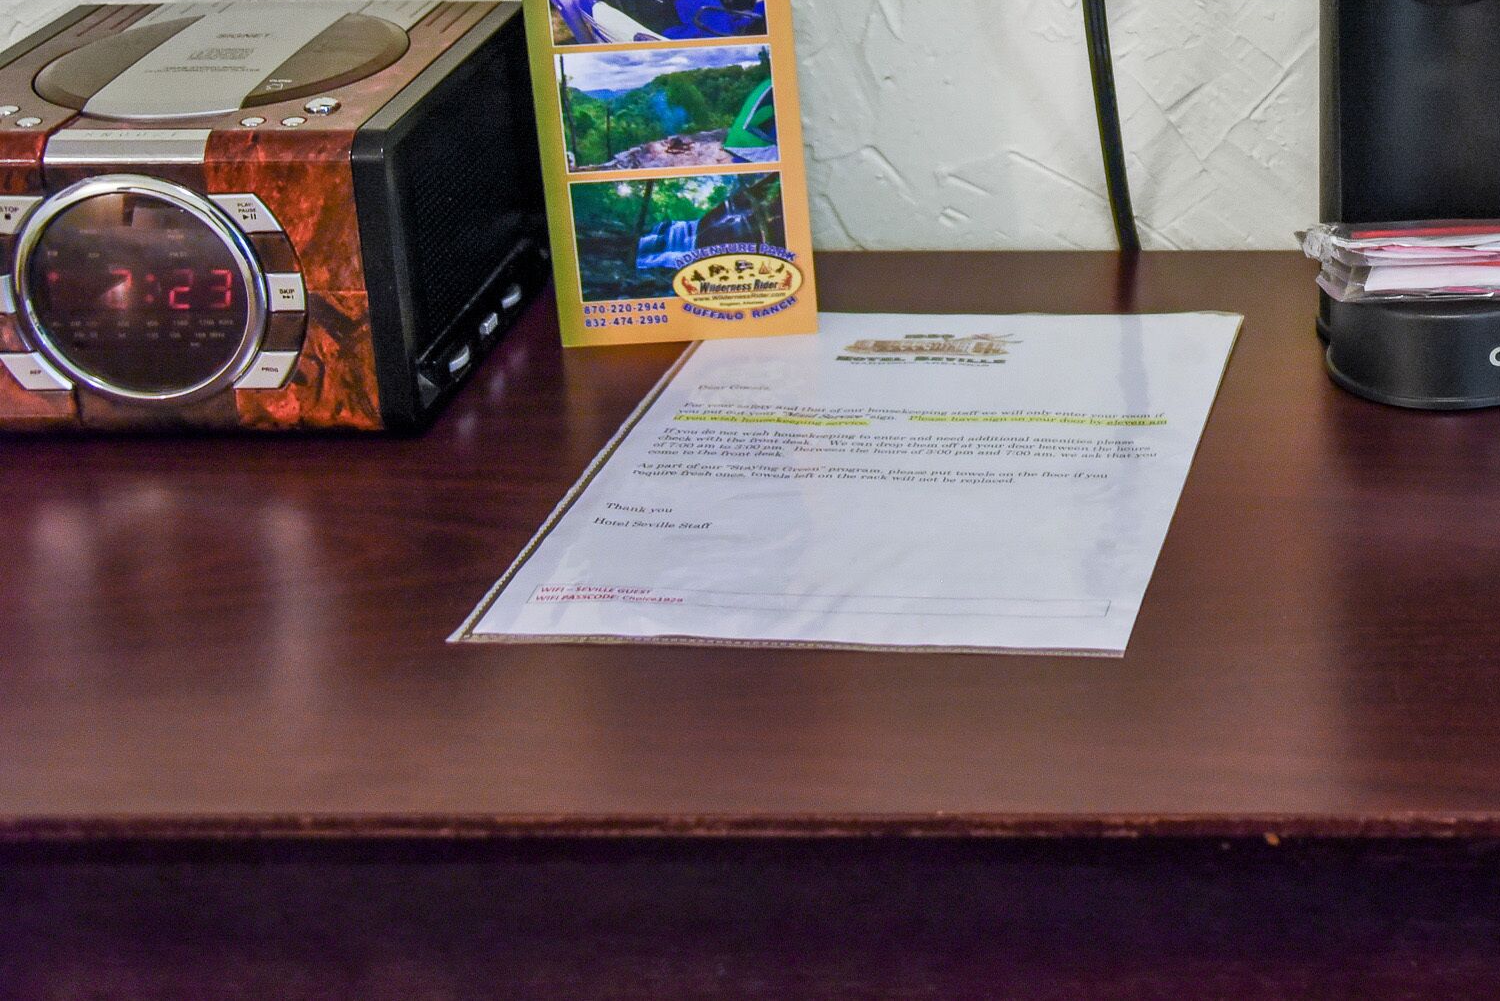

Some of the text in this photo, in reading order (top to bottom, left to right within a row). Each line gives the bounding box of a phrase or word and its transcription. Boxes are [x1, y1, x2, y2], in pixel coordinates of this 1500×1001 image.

[675, 242, 797, 269] ADVENTURE PARK
[700, 278, 779, 293] Wilderness Rider
[584, 302, 667, 315] 870-220-2944
[683, 295, 797, 321] BUFFALO RANCH
[585, 314, 669, 328] 832-474-2990
[658, 434, 692, 442] check
[774, 430, 855, 440] housekeeping
[606, 502, 646, 513] Thank
[594, 517, 628, 527] Hotel
